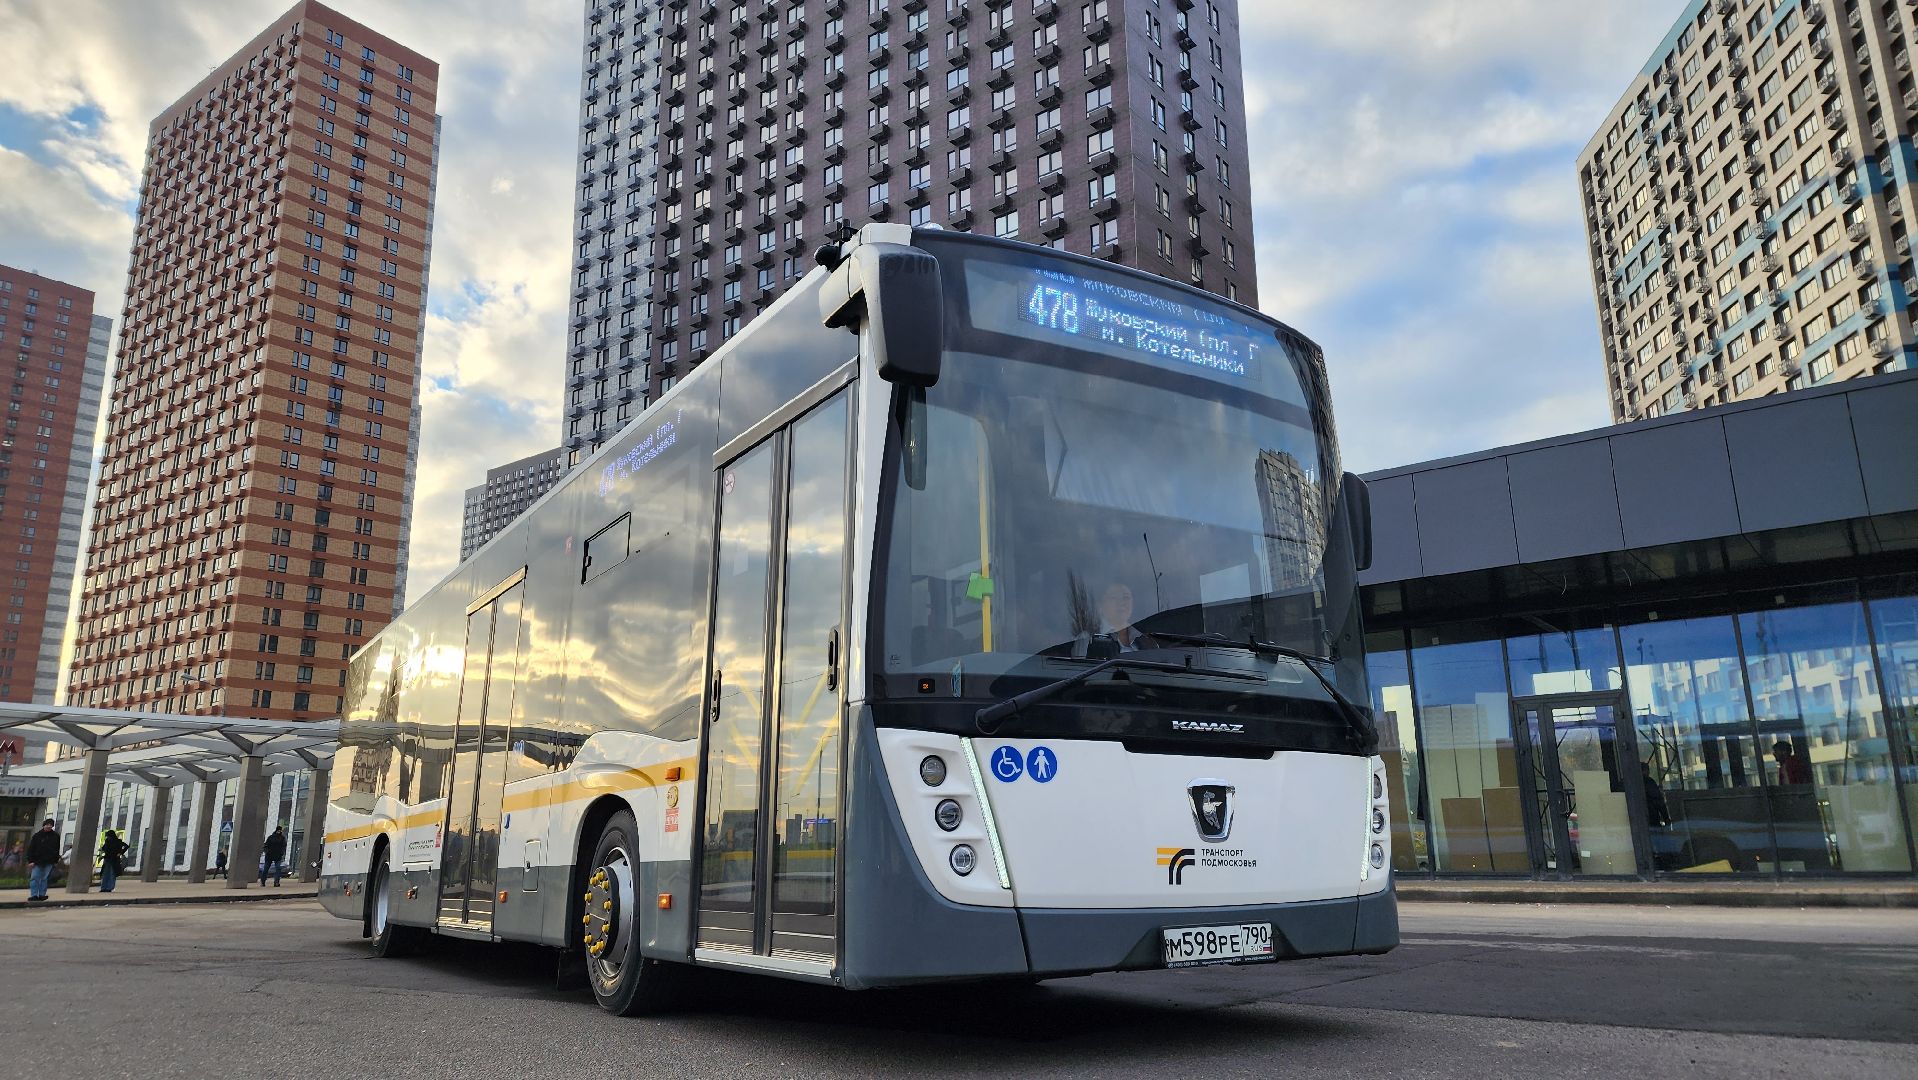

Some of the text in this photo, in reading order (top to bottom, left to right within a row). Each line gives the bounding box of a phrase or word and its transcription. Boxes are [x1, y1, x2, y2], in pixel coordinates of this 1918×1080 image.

[1029, 284, 1078, 333] 478
[1136, 330, 1245, 375] Котельники
[1172, 720, 1245, 733] KAMAZ
[1201, 848, 1244, 857] ТРАНСПОРТ
[1201, 858, 1257, 868] ПОДМОСКОВЬЯ
[1242, 925, 1268, 945] 790
